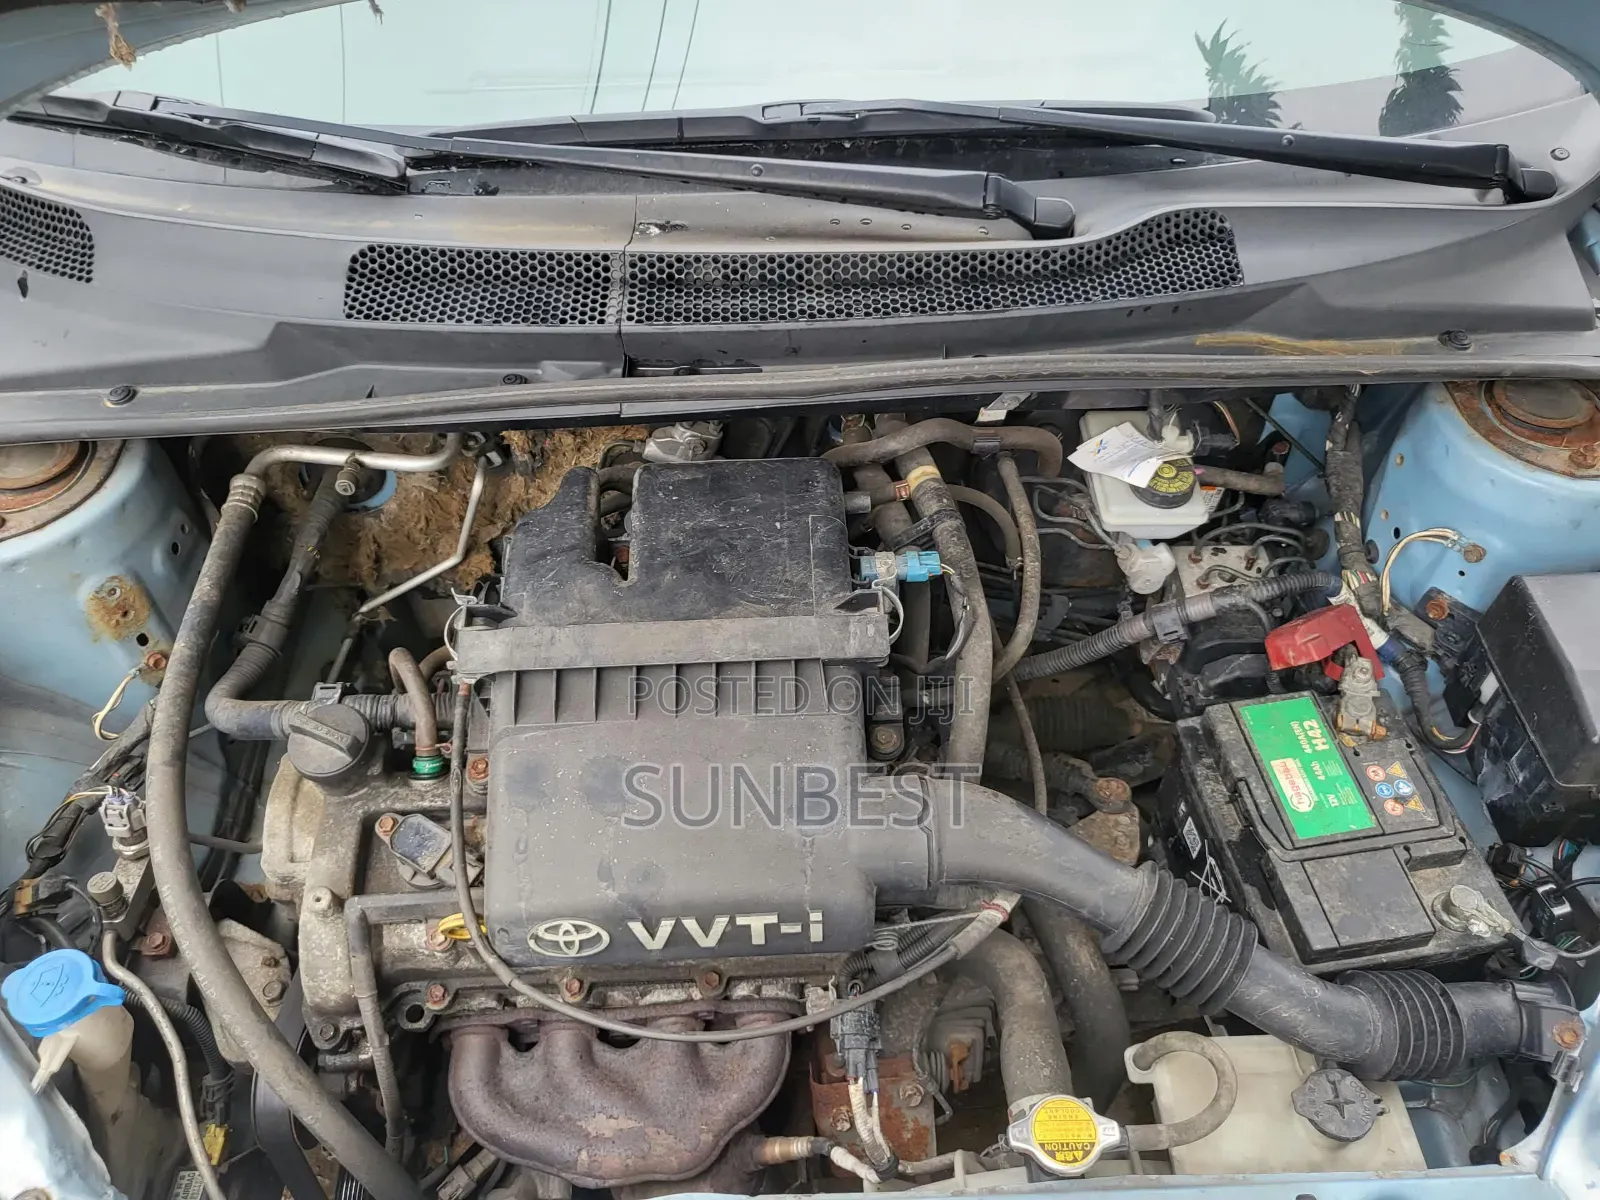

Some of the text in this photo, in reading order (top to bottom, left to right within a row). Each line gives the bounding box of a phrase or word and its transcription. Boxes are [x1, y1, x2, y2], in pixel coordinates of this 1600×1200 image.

[1302, 719, 1330, 751] H42
[627, 909, 825, 951] VVT-i
[1349, 1080, 1372, 1128] COOLANT
[1044, 1142, 1090, 1151] CAUTION
[181, 1172, 196, 1200] AIRBAG
